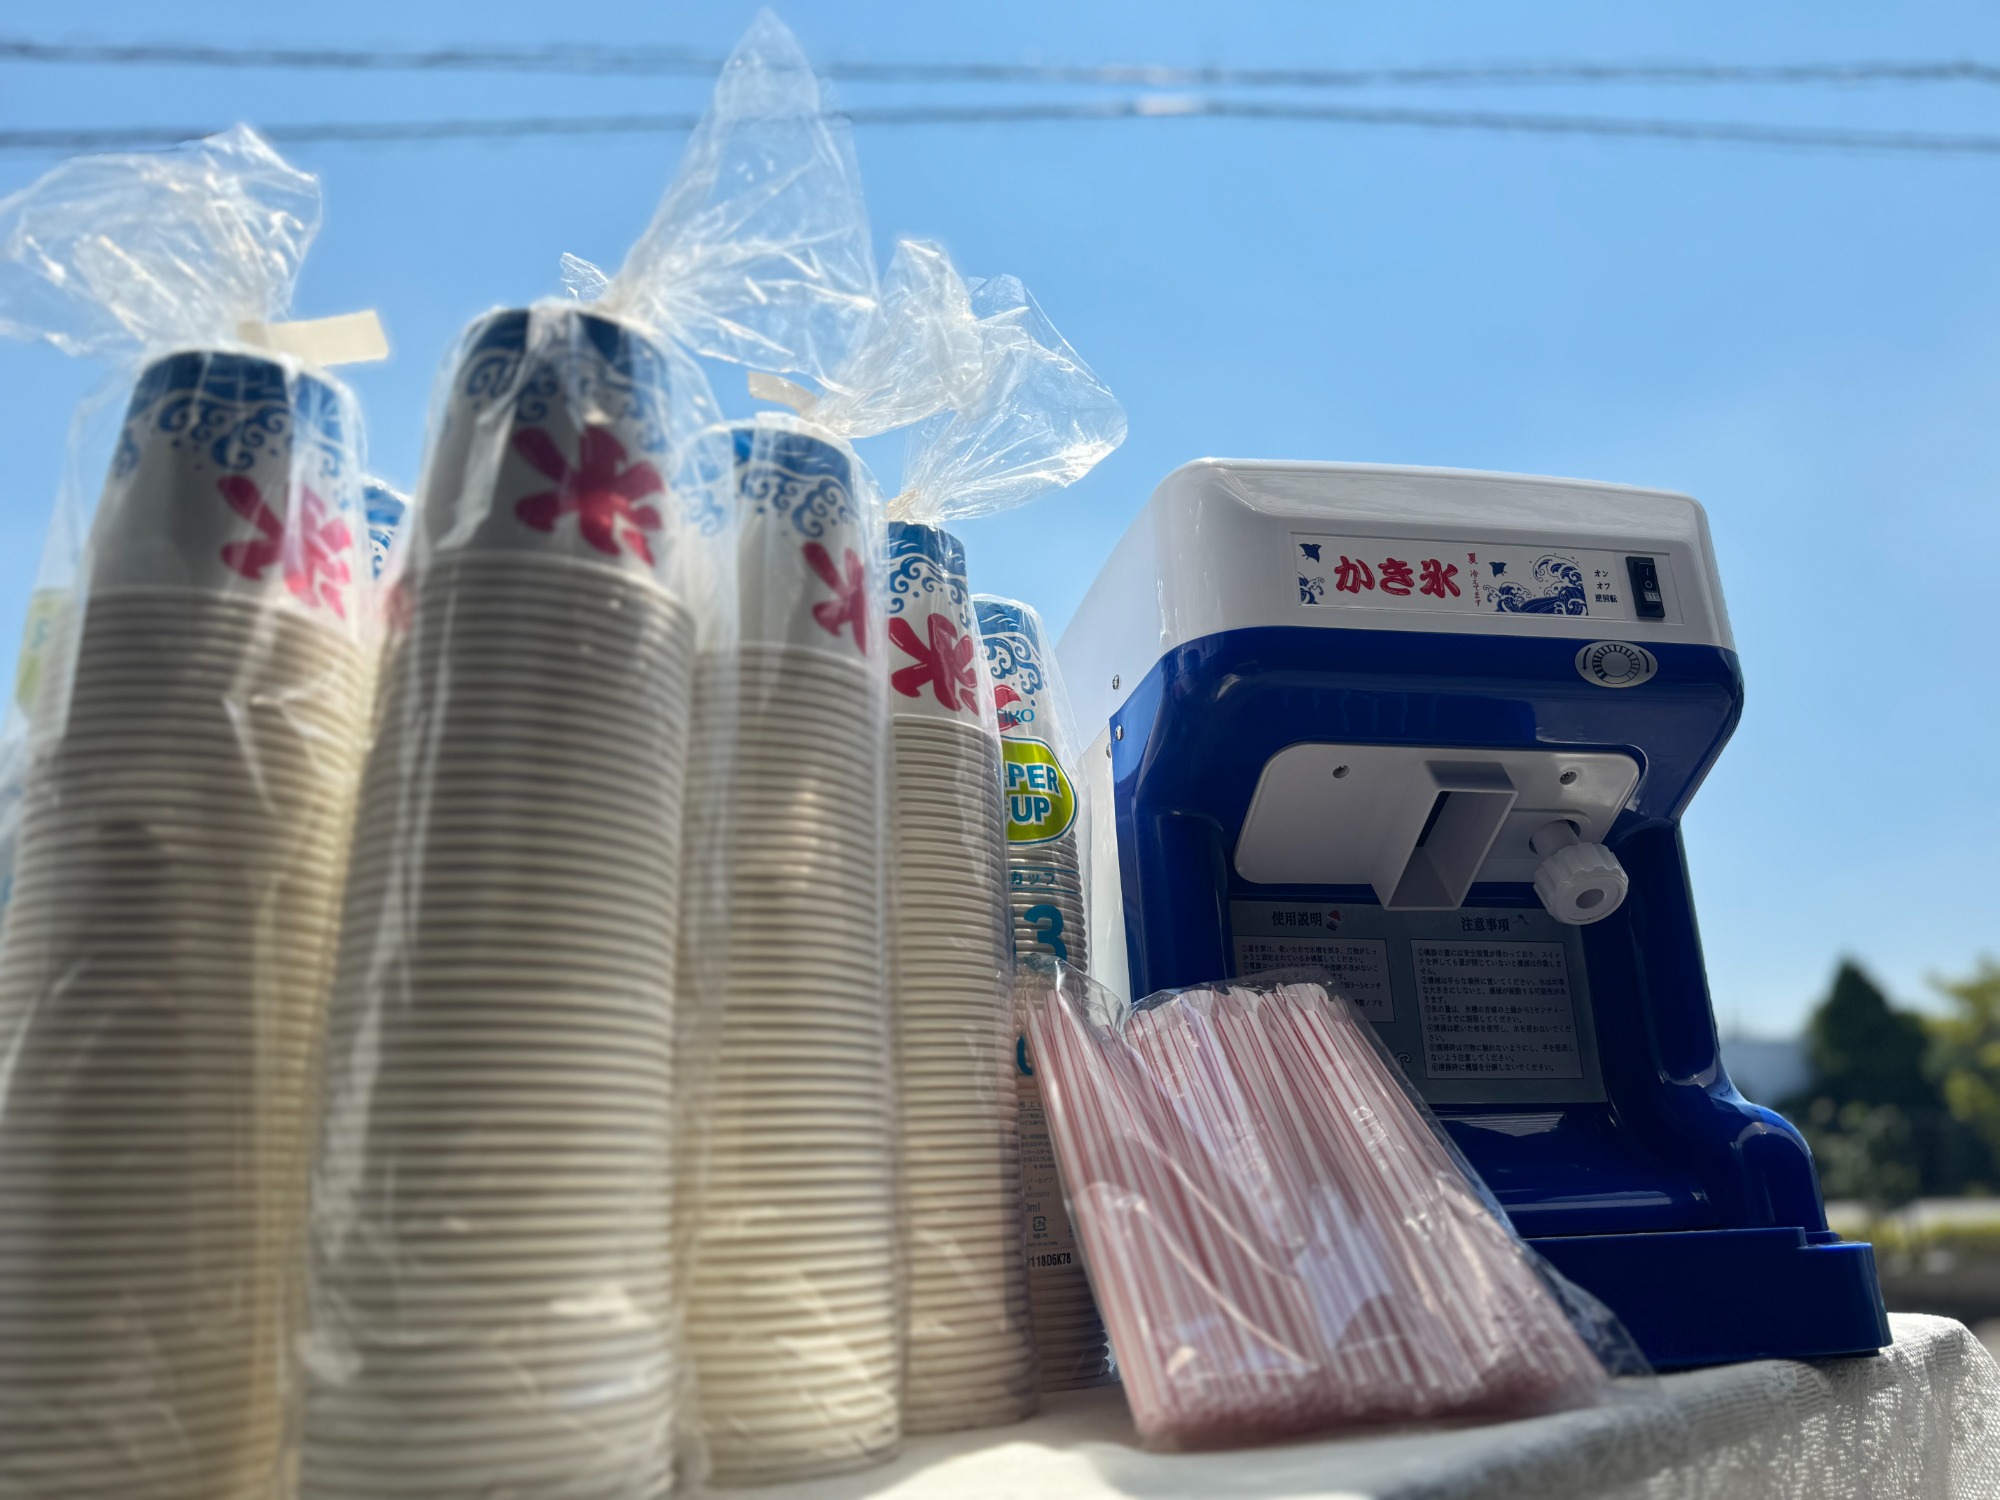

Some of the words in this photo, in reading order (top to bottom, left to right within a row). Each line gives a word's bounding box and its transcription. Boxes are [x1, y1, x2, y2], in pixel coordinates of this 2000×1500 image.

[1334, 555, 1461, 599] かき氷
[1594, 569, 1609, 578] オン
[1596, 581, 1611, 590] オフ
[1595, 593, 1618, 603] 逆回転
[889, 612, 979, 718] 氷
[1004, 762, 1060, 794] PER
[1005, 795, 1050, 822] UP
[1272, 910, 1323, 927] 使用説明
[1460, 915, 1510, 932] 注意事項
